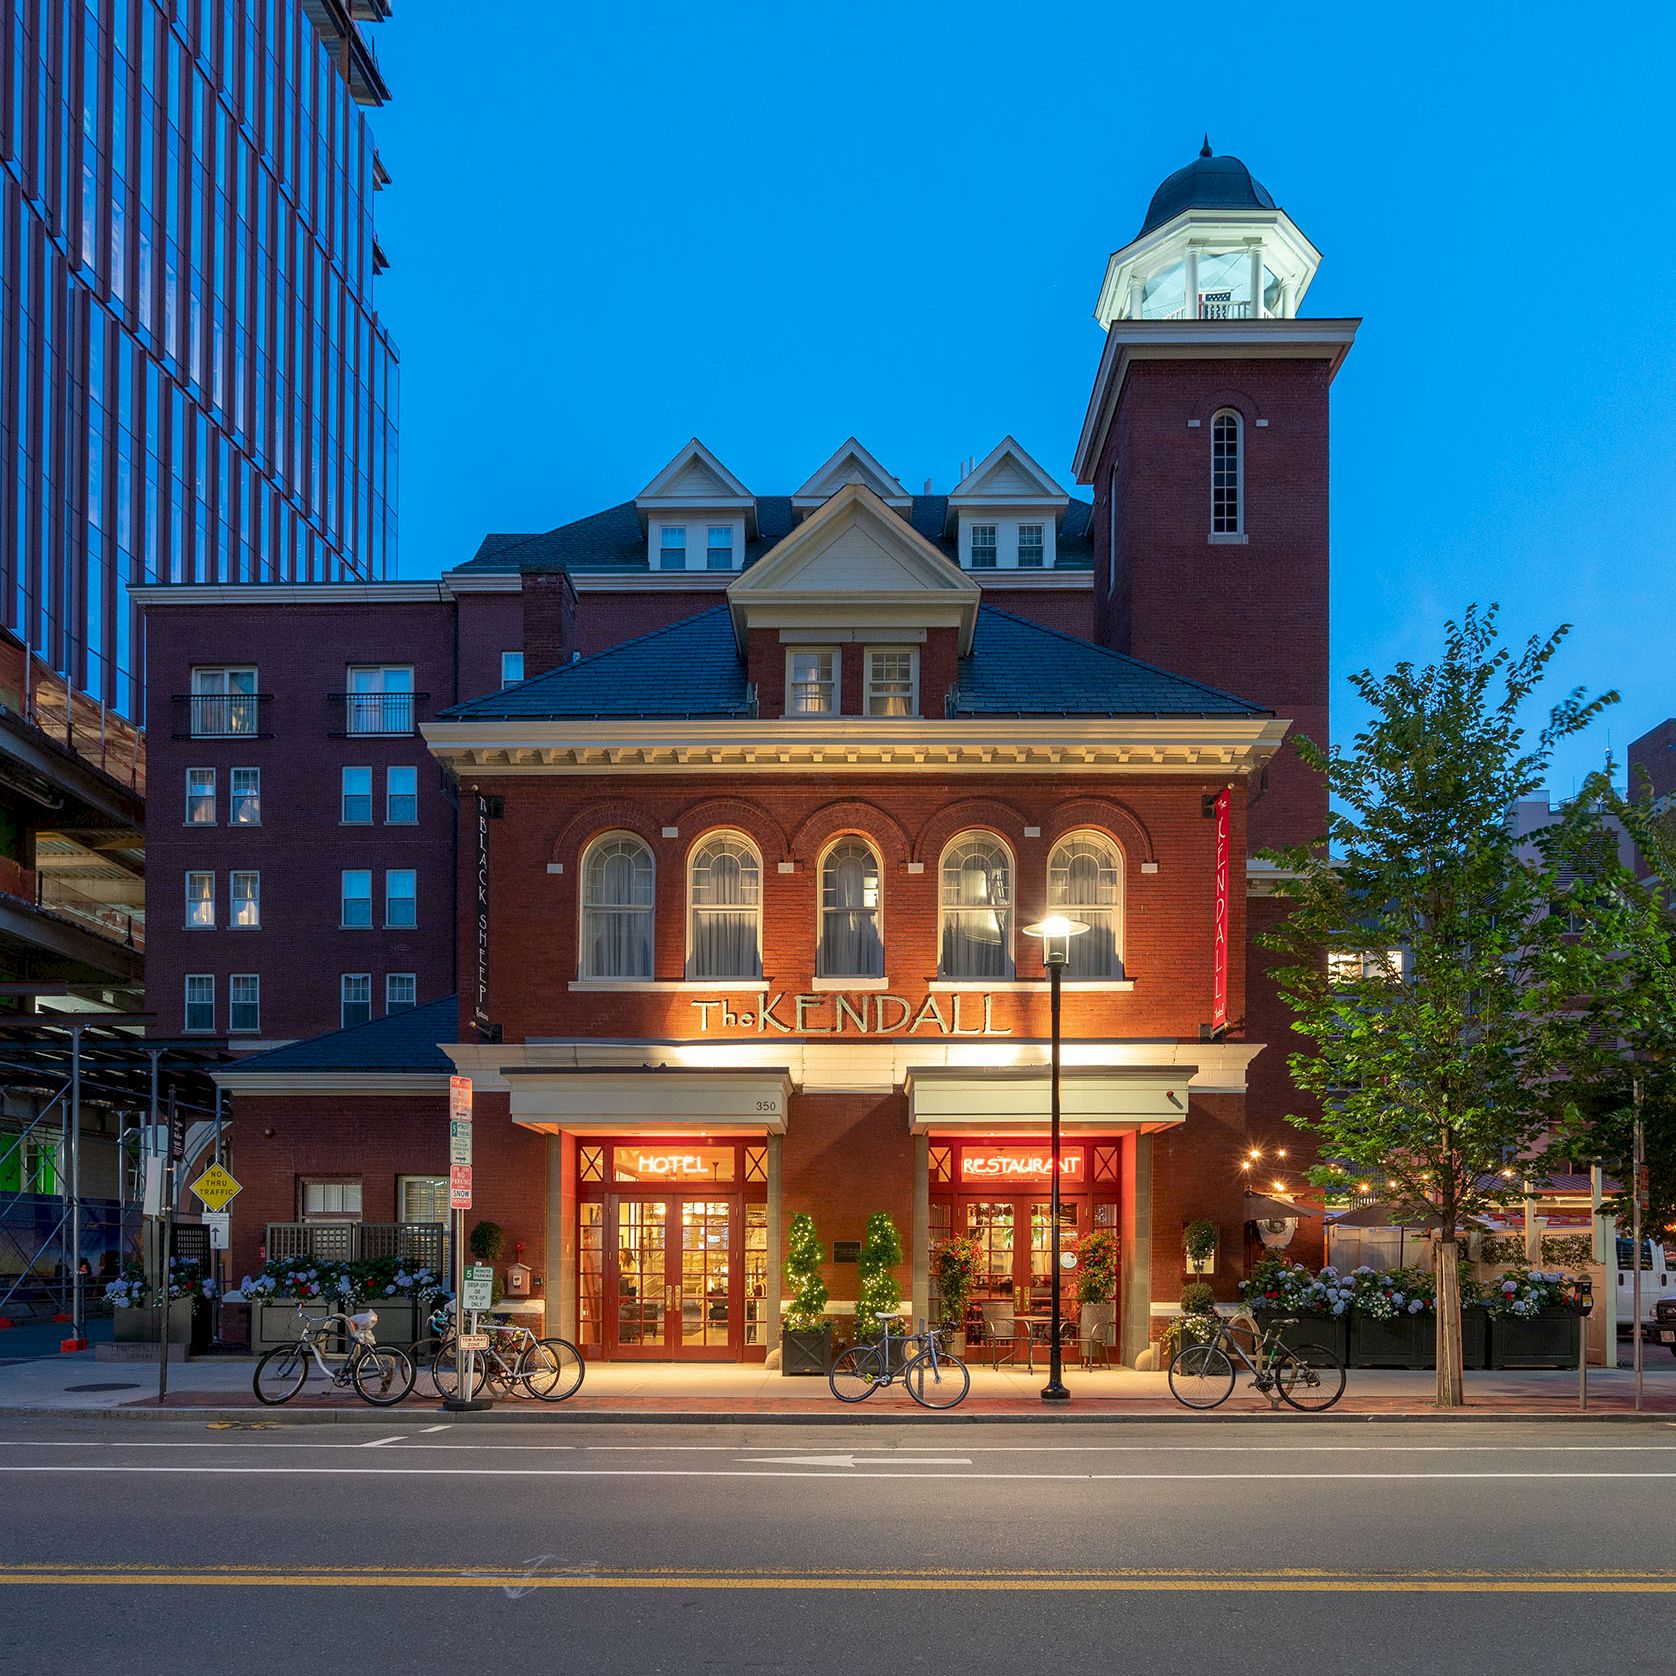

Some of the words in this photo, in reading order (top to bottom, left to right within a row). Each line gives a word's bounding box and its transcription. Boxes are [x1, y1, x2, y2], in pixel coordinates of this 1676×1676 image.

[478, 816, 488, 905] BLACK
[1216, 816, 1226, 998] KENDALL
[478, 915, 488, 1004] SHEEP
[690, 1000, 755, 1032] The
[757, 991, 1011, 1035] KENDALL
[756, 1101, 776, 1112] 350
[453, 1124, 457, 1134] 5
[638, 1155, 709, 1173] HOTEL
[963, 1157, 1081, 1173] RESTAURANT
[206, 1179, 227, 1187] THRU
[453, 1190, 470, 1198] SNOW
[466, 1269, 472, 1278] 5
